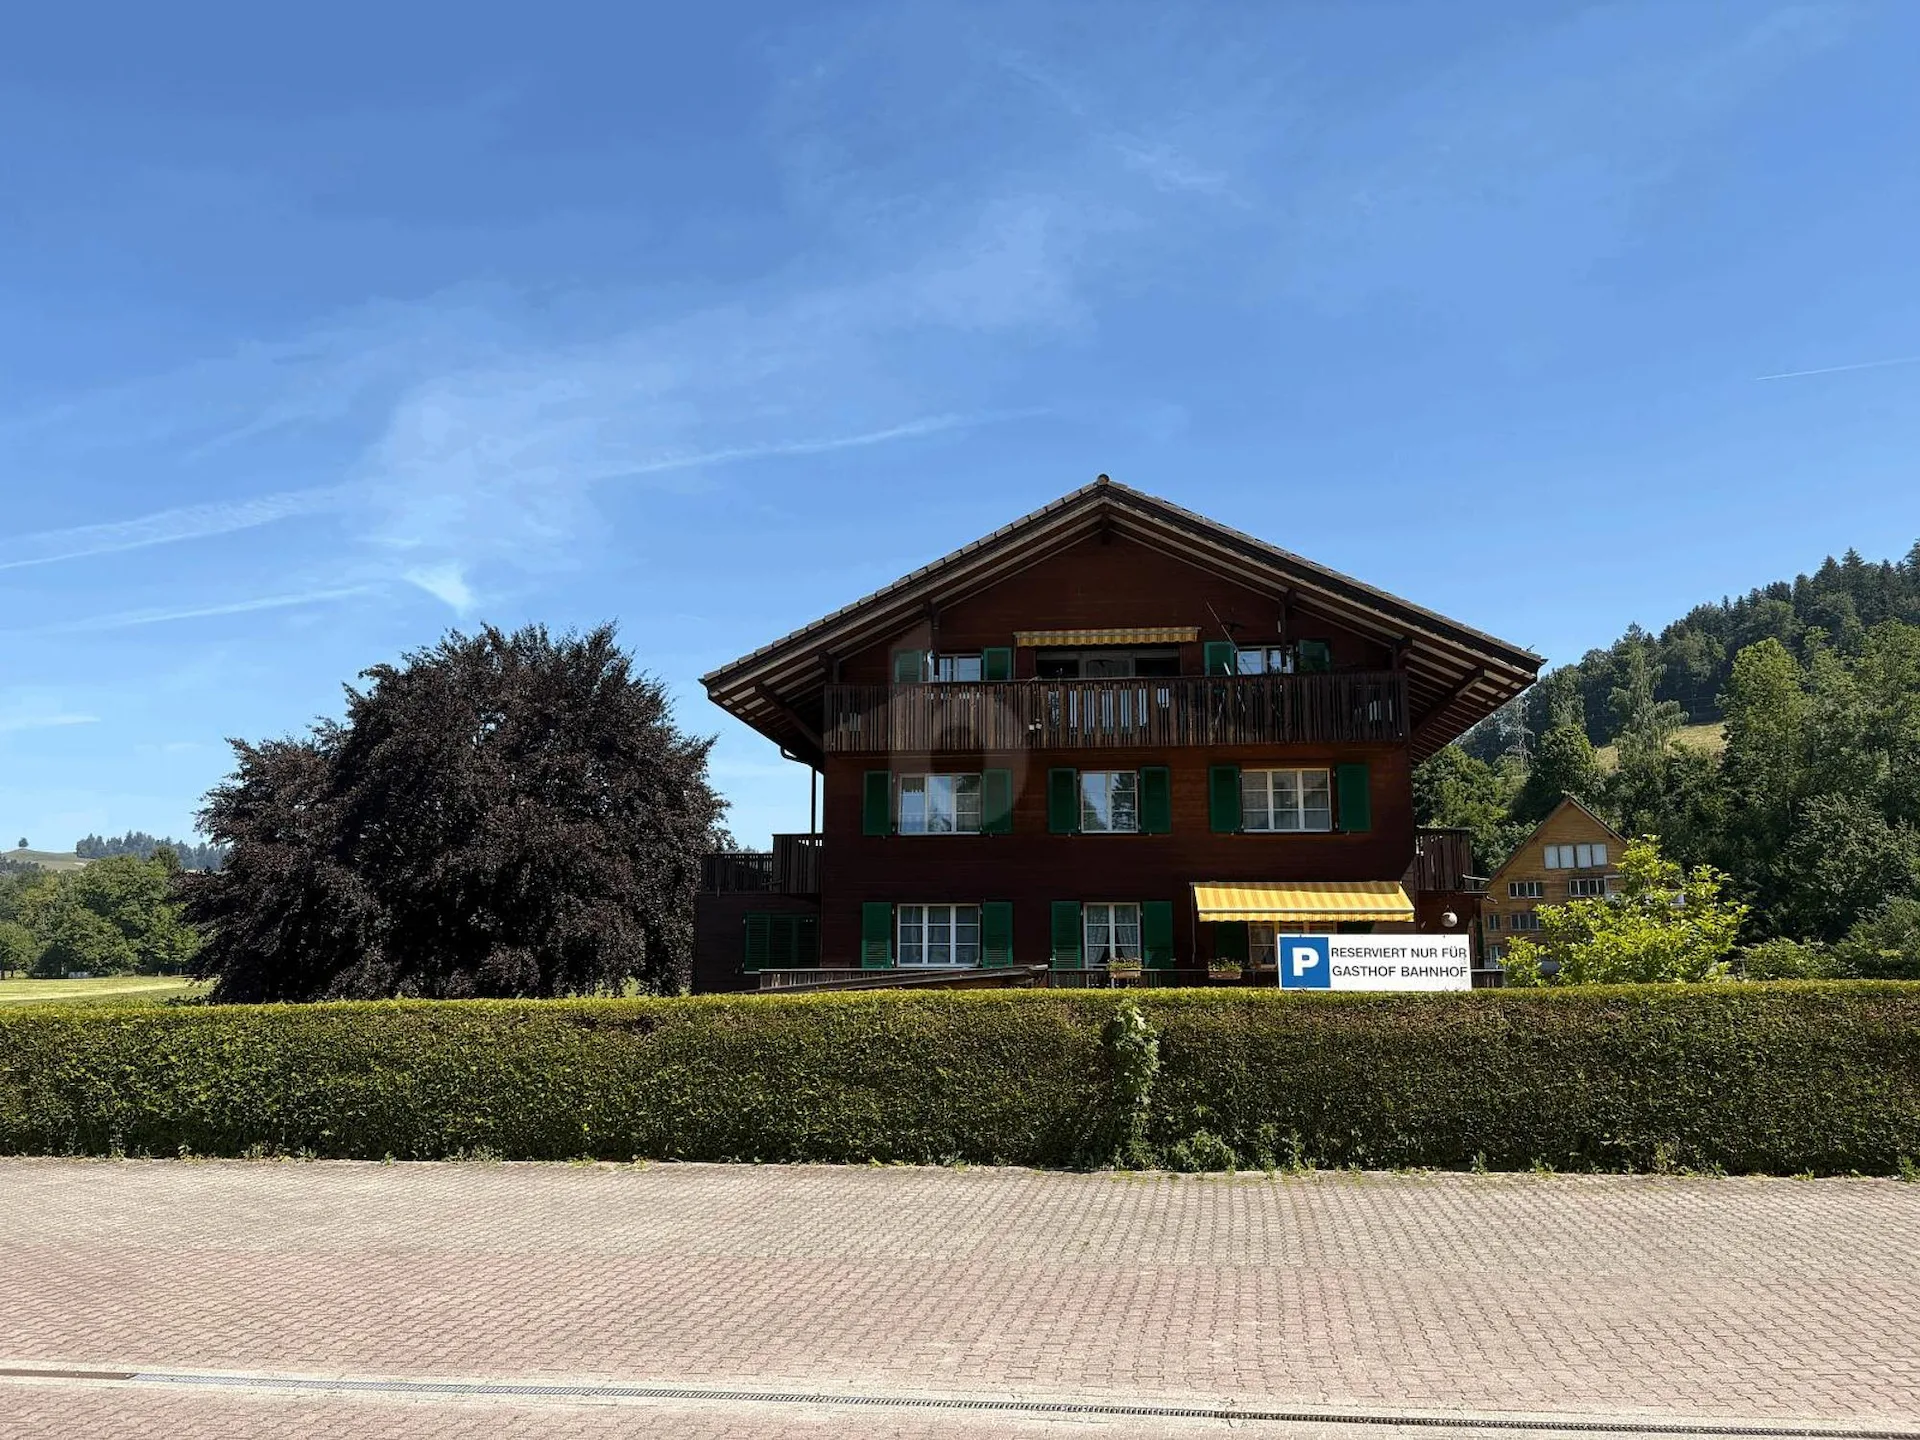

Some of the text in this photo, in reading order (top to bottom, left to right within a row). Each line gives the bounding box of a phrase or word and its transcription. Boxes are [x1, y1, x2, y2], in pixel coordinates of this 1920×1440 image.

[1331, 946, 1467, 958] RESERVIERT NUR FÜR
[1332, 965, 1468, 977] GASTHOF BAHNHOF
